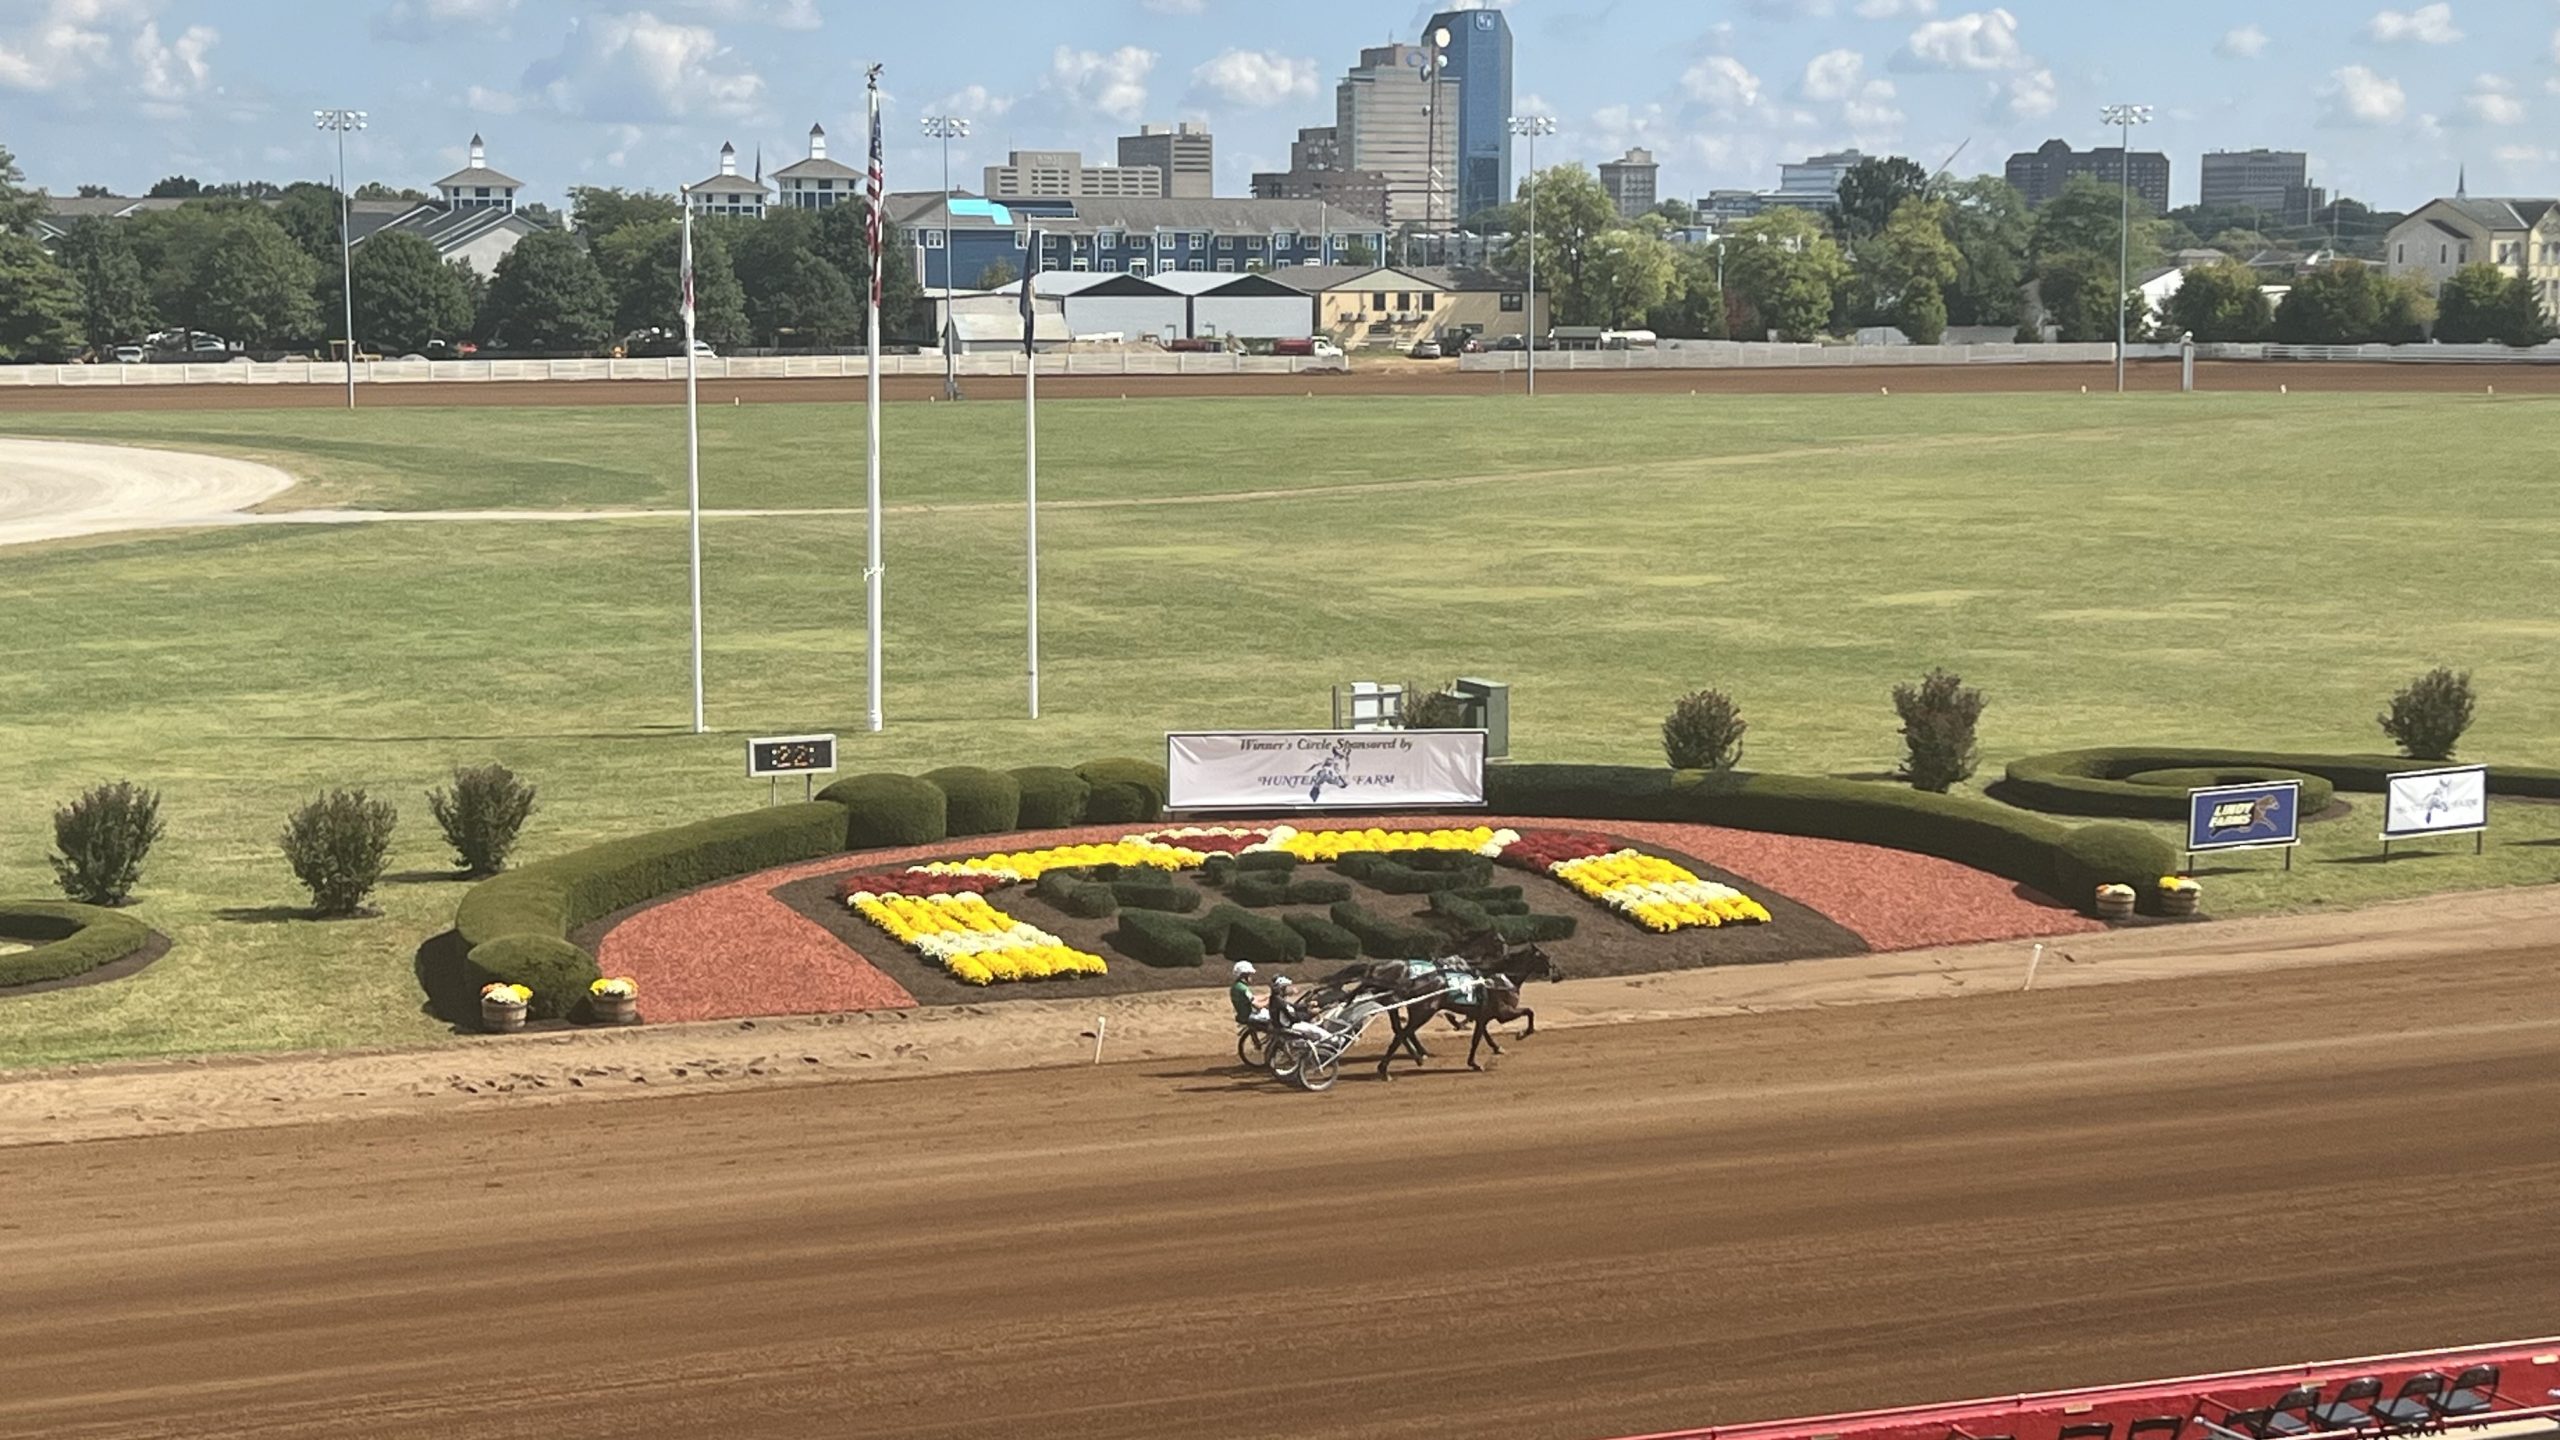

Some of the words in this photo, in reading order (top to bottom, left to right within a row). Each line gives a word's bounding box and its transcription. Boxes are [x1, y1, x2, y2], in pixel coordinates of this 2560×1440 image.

[1240, 737, 1293, 751] Winner's
[1297, 737, 1331, 750] Circle
[1336, 737, 1397, 751] Sponsored
[1399, 737, 1413, 752] by
[1352, 774, 1395, 786] FARM
